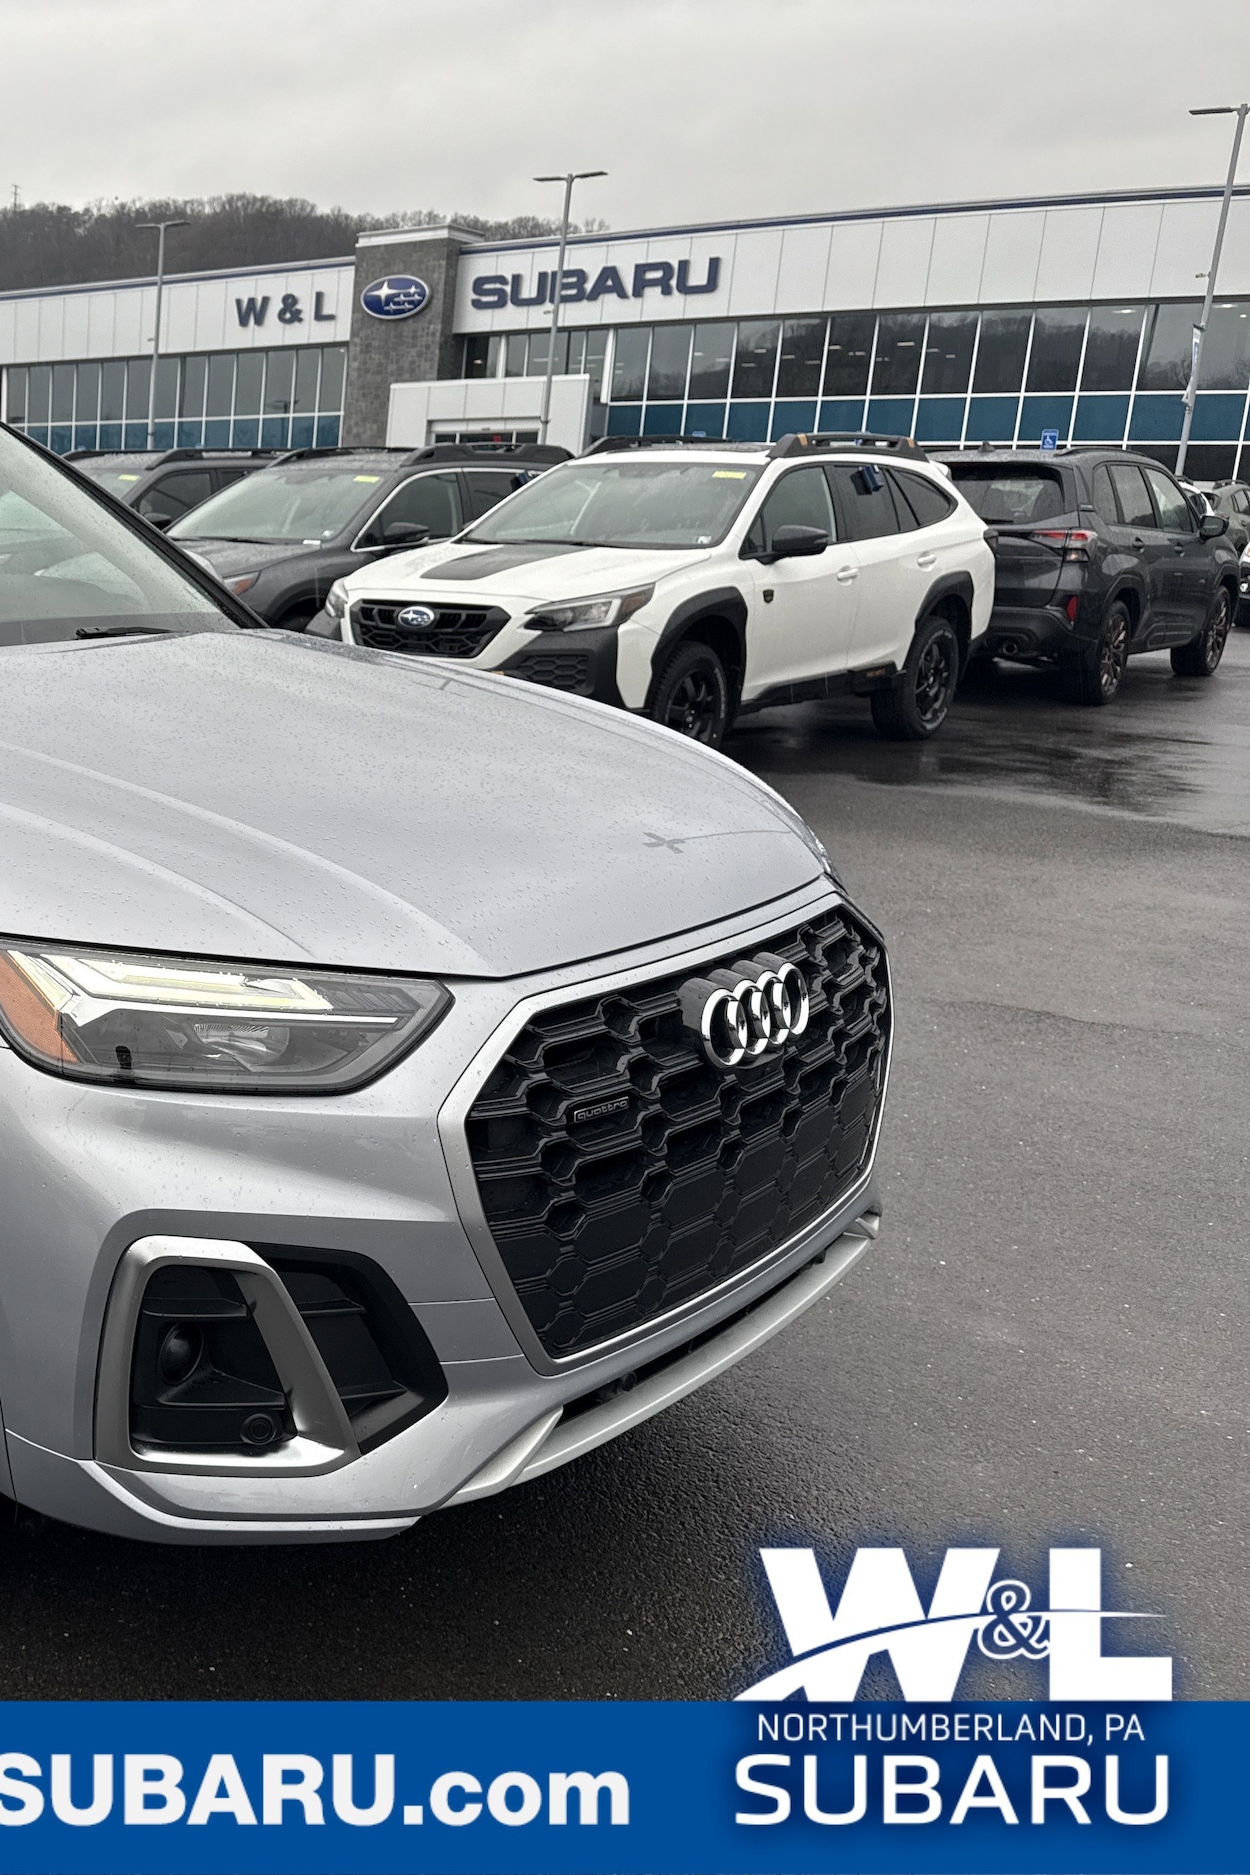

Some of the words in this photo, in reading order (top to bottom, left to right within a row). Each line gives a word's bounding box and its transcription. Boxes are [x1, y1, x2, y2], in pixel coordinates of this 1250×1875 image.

[471, 256, 722, 310] SUBARU
[235, 296, 270, 328] W
[277, 293, 304, 324] &
[314, 291, 336, 322] L
[577, 1100, 628, 1120] quattro
